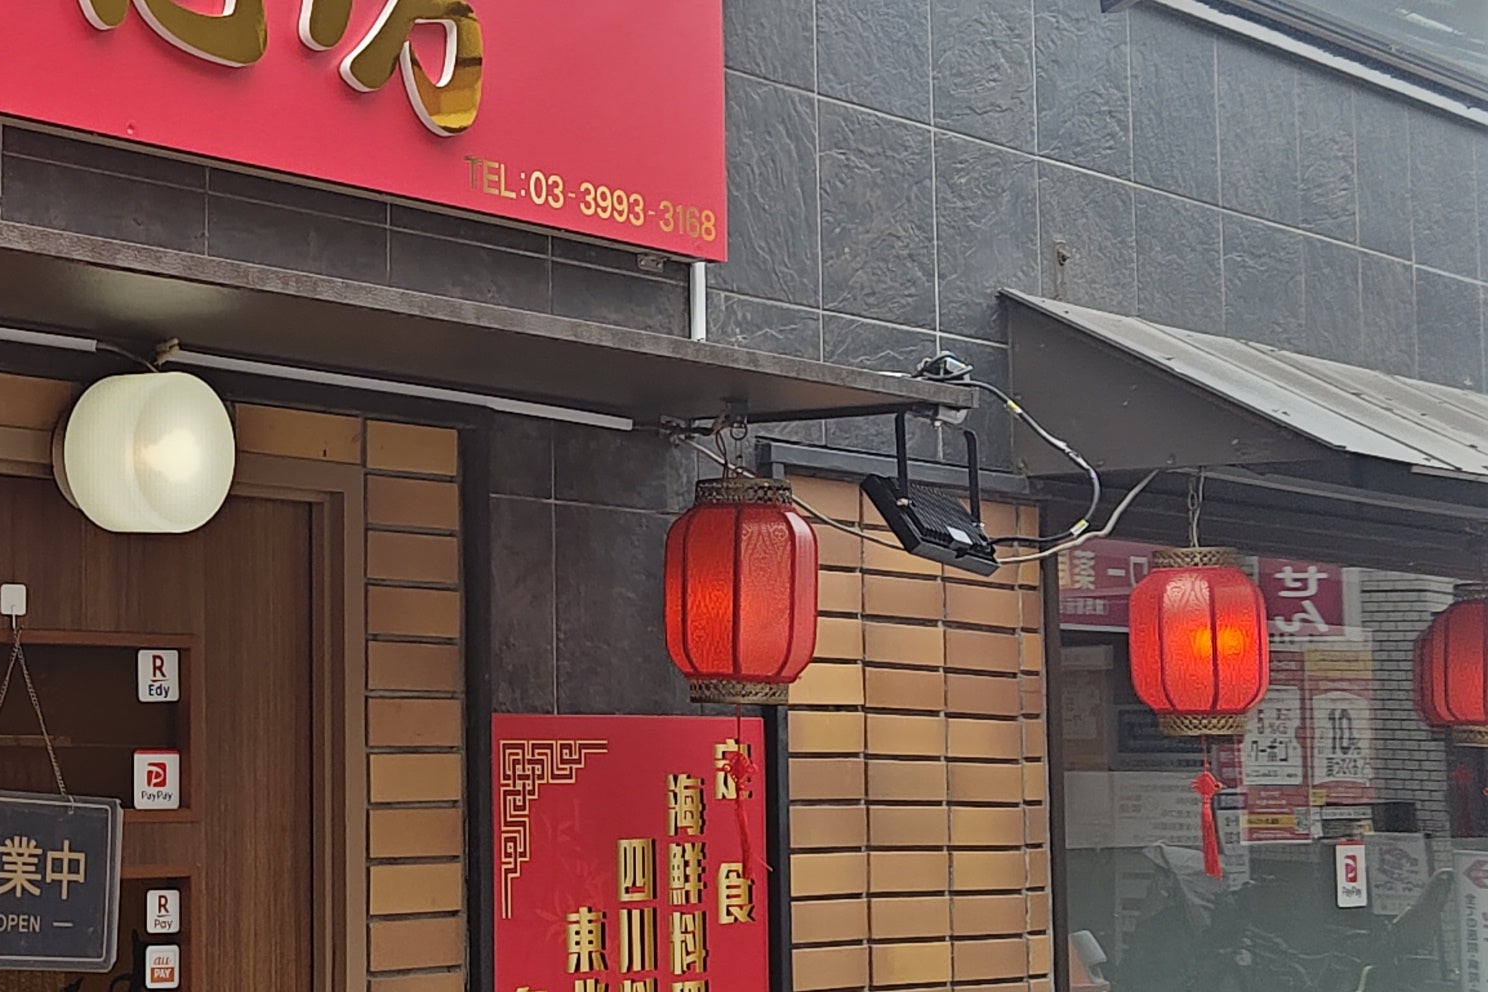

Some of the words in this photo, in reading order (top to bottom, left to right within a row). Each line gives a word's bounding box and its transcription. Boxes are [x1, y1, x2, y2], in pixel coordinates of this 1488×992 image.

[464, 155, 717, 242] TEL:03-3993-3168
[148, 684, 171, 699] Edy
[141, 790, 173, 802] PayPay
[667, 773, 708, 992] 海鮮料
[616, 838, 657, 992] 四川
[153, 919, 173, 931] Pay
[153, 968, 172, 979] PAY
